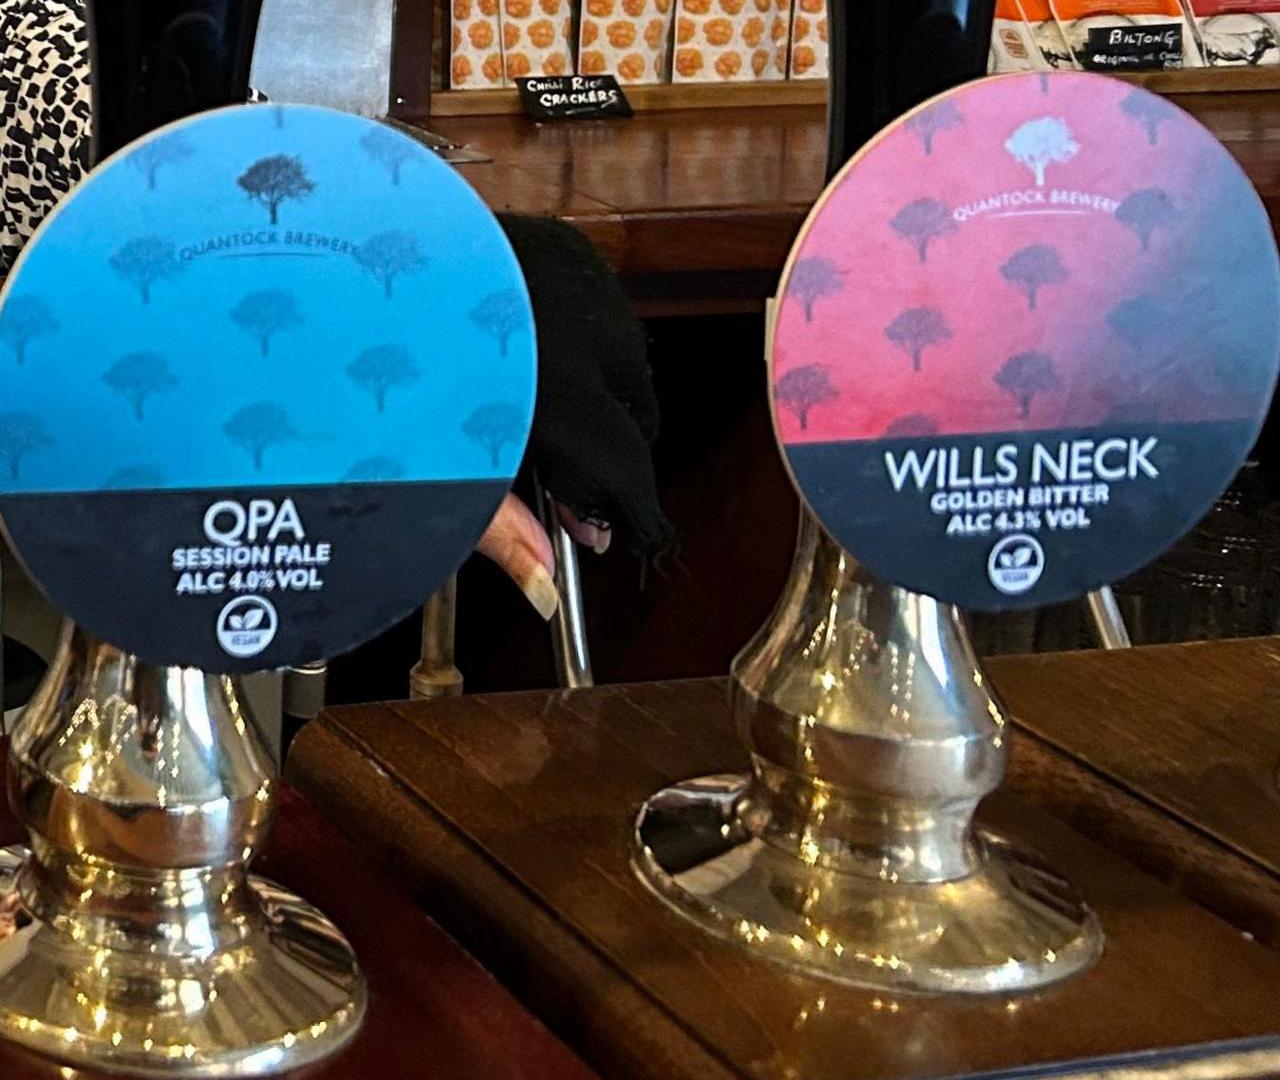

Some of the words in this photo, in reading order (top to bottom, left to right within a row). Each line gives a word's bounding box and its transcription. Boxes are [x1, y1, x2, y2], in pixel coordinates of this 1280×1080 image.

[1108, 29, 1178, 49] BILTONG
[539, 90, 618, 108] CRACKERS
[952, 189, 1045, 221] QUANTOCK
[1049, 189, 1122, 212] BREWERY
[179, 230, 279, 262] QUANTOCK
[283, 231, 361, 256] BREWERY
[884, 443, 1019, 492] WILLS
[1030, 436, 1160, 483] NECK
[930, 487, 1025, 514] GOLDEN
[1028, 483, 1110, 508] BITTER
[203, 496, 306, 547] QPA
[946, 513, 992, 536] ALC
[994, 511, 1042, 531] 4.3%
[1044, 506, 1091, 530] VOL
[171, 546, 271, 570] SESSION
[274, 543, 332, 566] PALE
[175, 572, 225, 596] ALC
[227, 570, 276, 592] 4.0%
[276, 569, 324, 591] VOL
